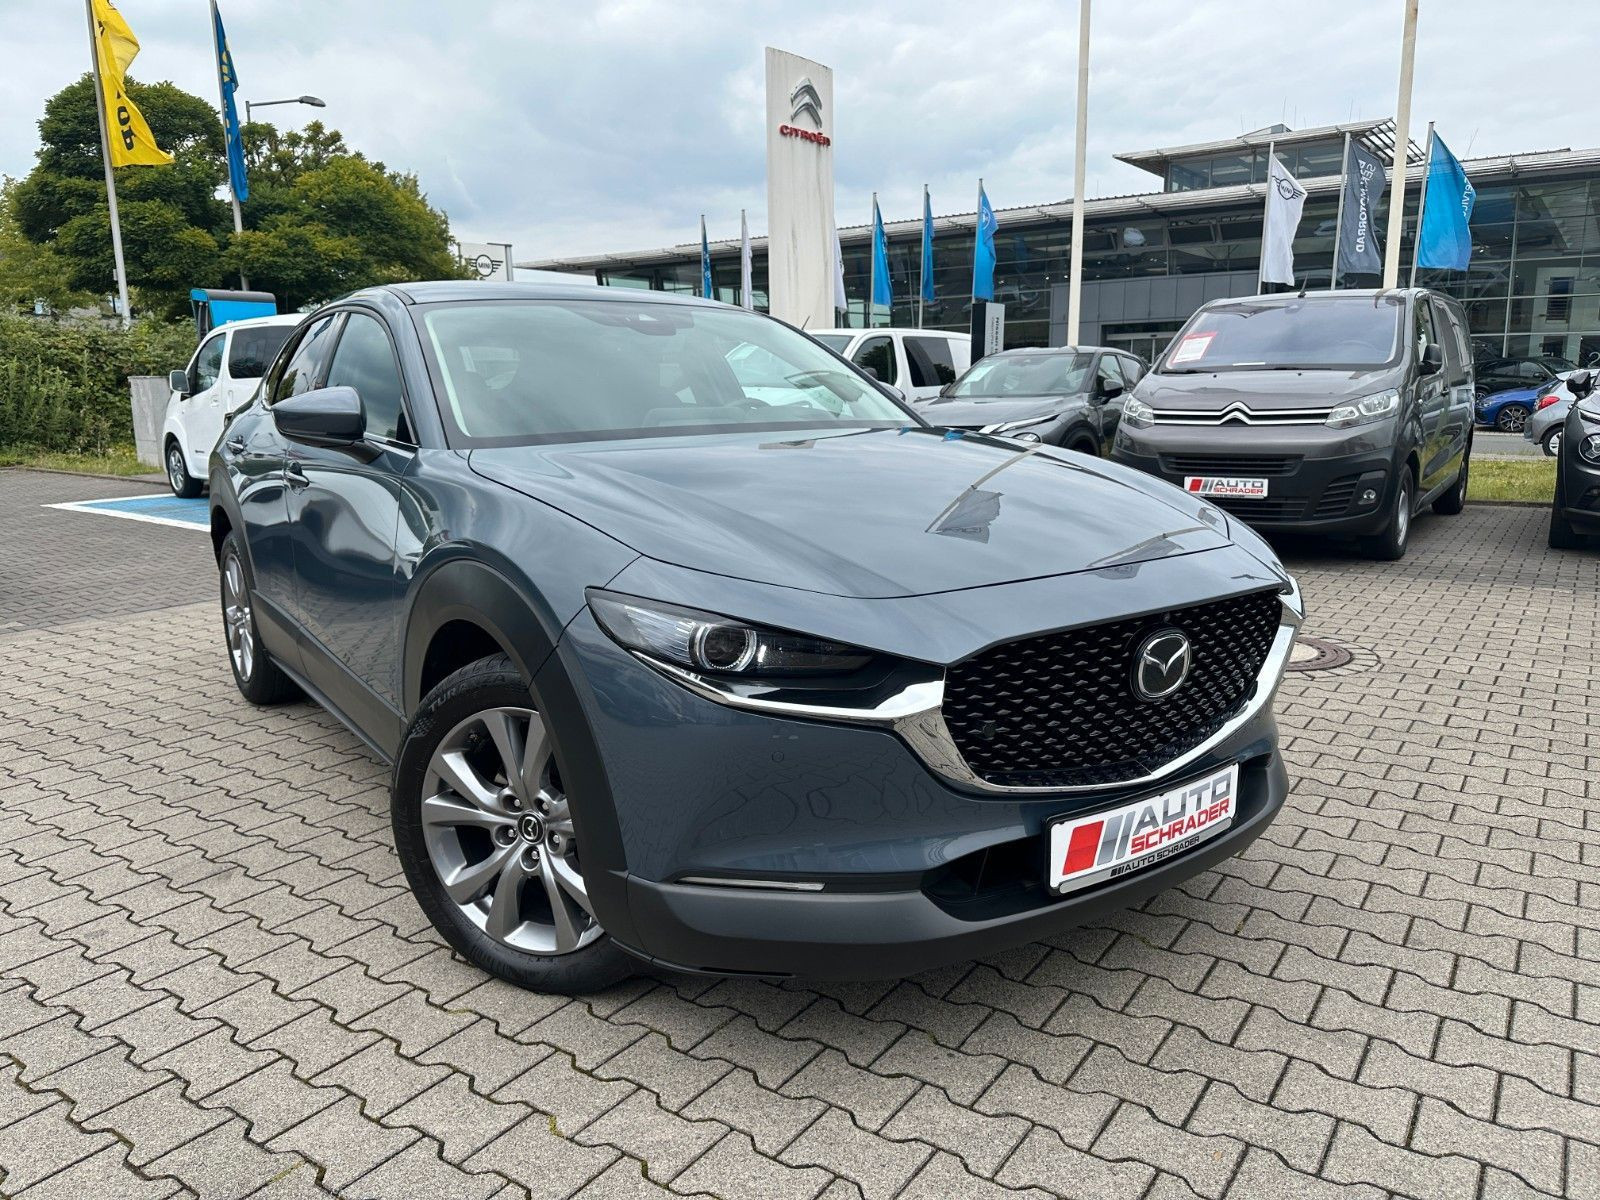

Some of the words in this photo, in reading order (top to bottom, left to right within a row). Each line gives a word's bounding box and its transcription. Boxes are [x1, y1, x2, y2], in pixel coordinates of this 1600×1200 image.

[1214, 479, 1264, 488] AUTO
[1130, 797, 1230, 855] SCHRADER
[1132, 771, 1232, 837] AUTO
[1124, 854, 1155, 873] AUTO
[1156, 835, 1200, 860] SCHRADER
